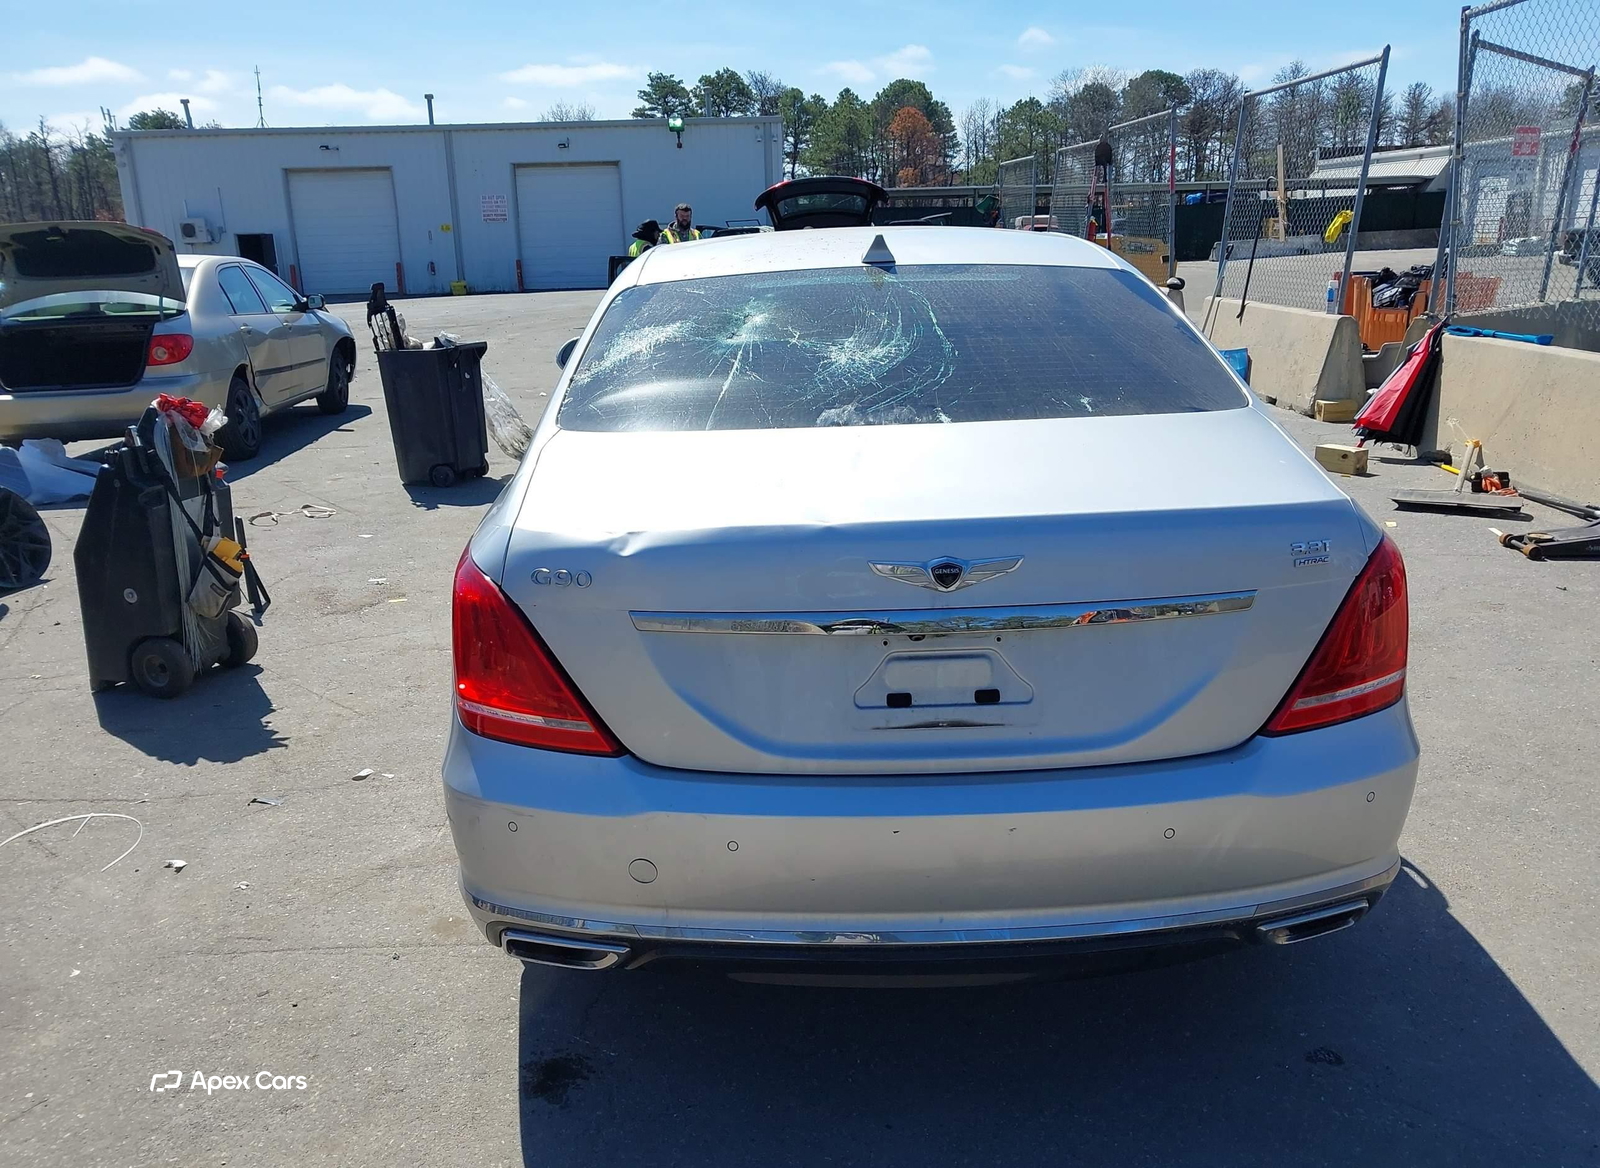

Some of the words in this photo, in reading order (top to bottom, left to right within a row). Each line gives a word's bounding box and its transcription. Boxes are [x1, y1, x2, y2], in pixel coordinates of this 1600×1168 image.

[1290, 539, 1332, 556] 3.3T
[1298, 556, 1329, 566] HTRAC
[530, 567, 593, 589] G90
